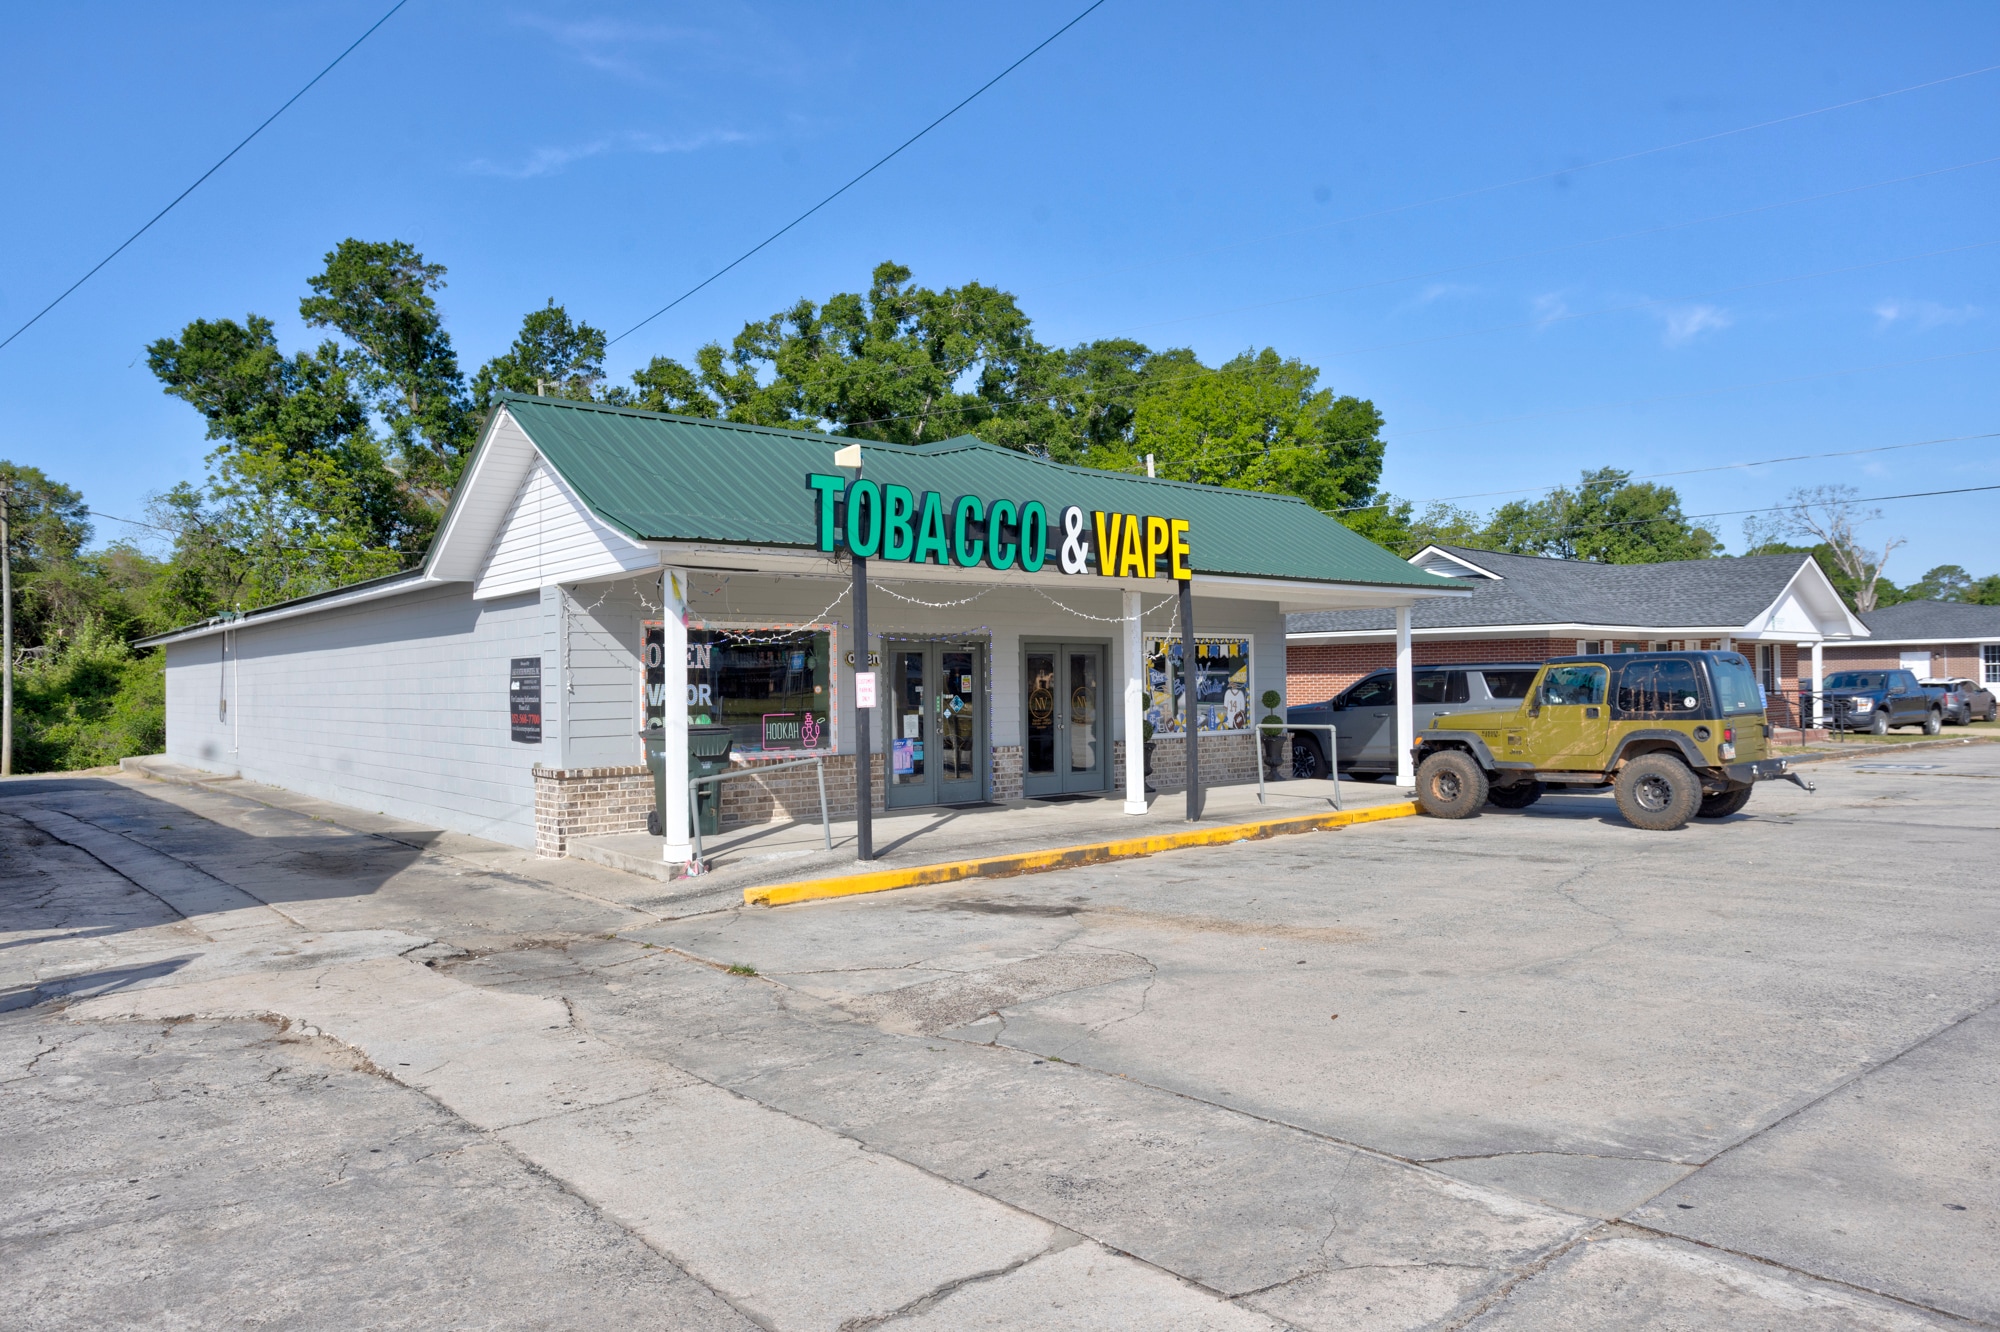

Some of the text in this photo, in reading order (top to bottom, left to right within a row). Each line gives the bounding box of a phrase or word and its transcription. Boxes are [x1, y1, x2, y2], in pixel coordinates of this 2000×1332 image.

[806, 473, 1192, 580] TOBACCO & VAPE
[646, 643, 712, 669] OEN
[1229, 700, 1238, 712] 14
[766, 722, 800, 740] HOOKAH
